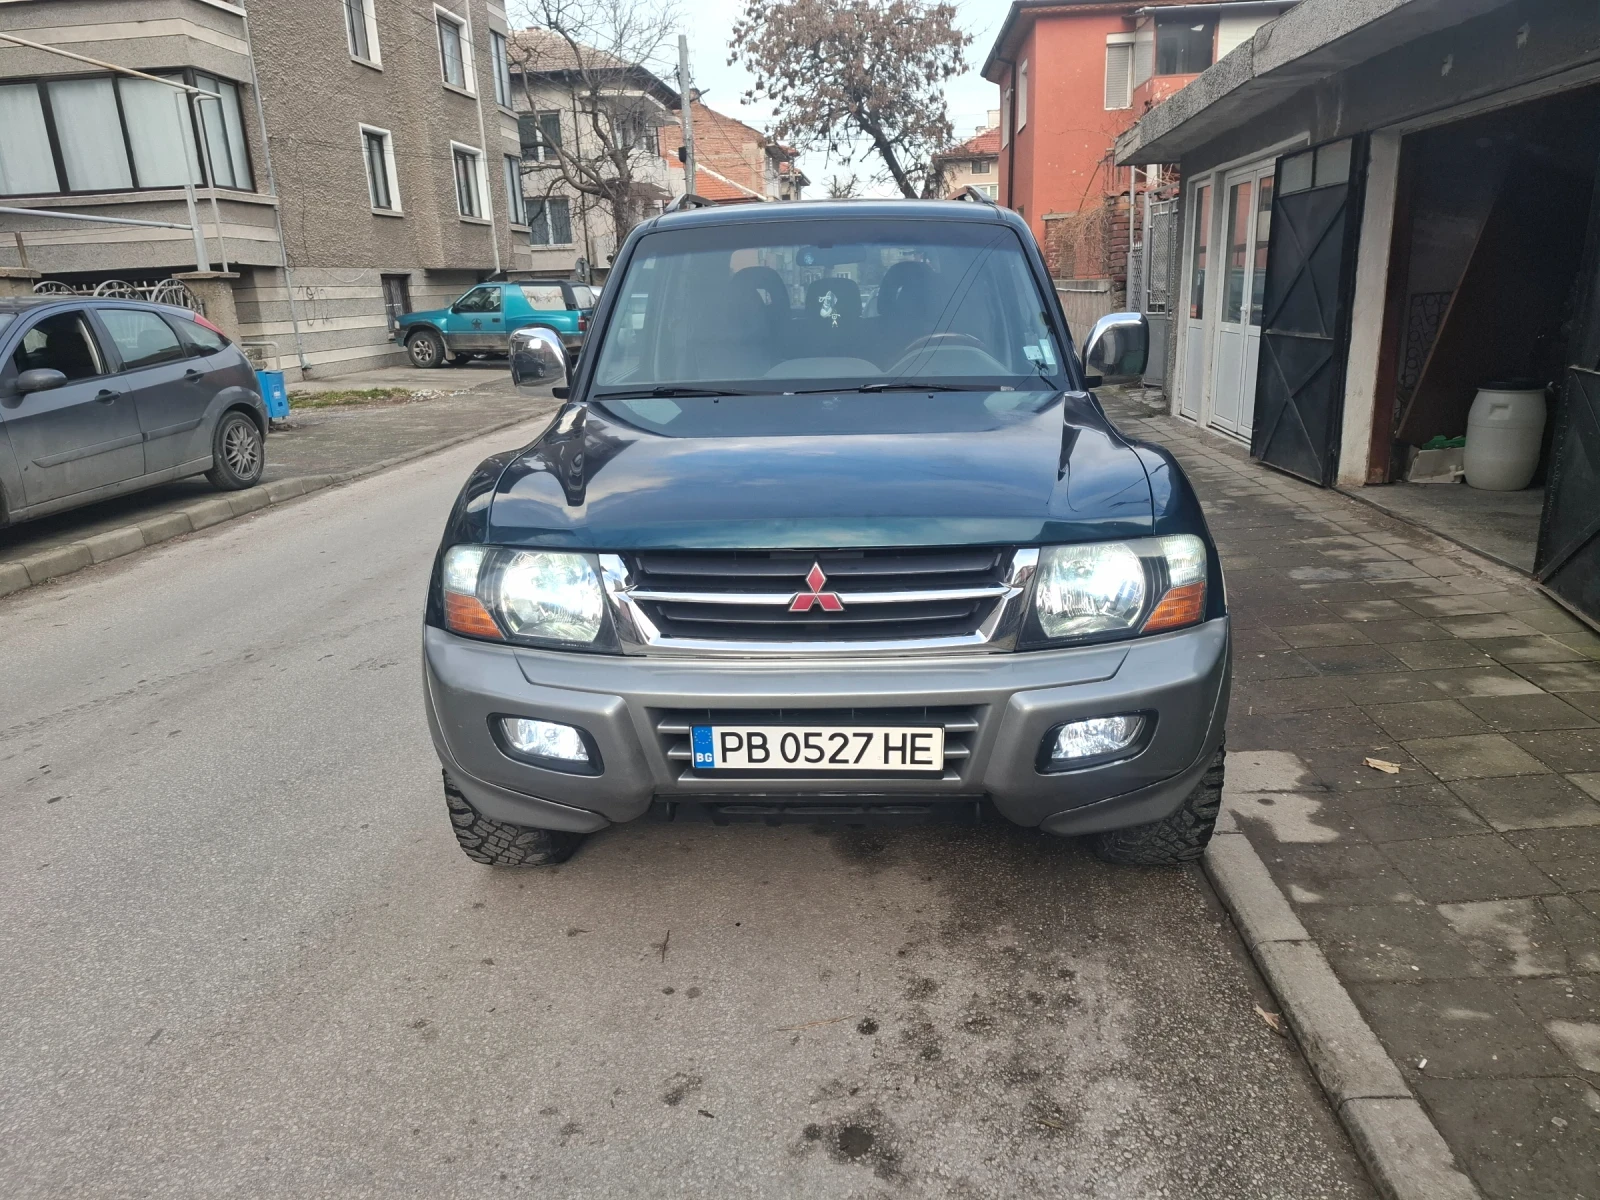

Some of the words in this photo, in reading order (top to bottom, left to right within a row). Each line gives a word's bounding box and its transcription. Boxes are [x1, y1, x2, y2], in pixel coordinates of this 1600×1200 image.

[696, 752, 713, 763] BG
[720, 731, 770, 763] PB
[780, 732, 874, 764] 0527
[883, 732, 933, 765] HE
